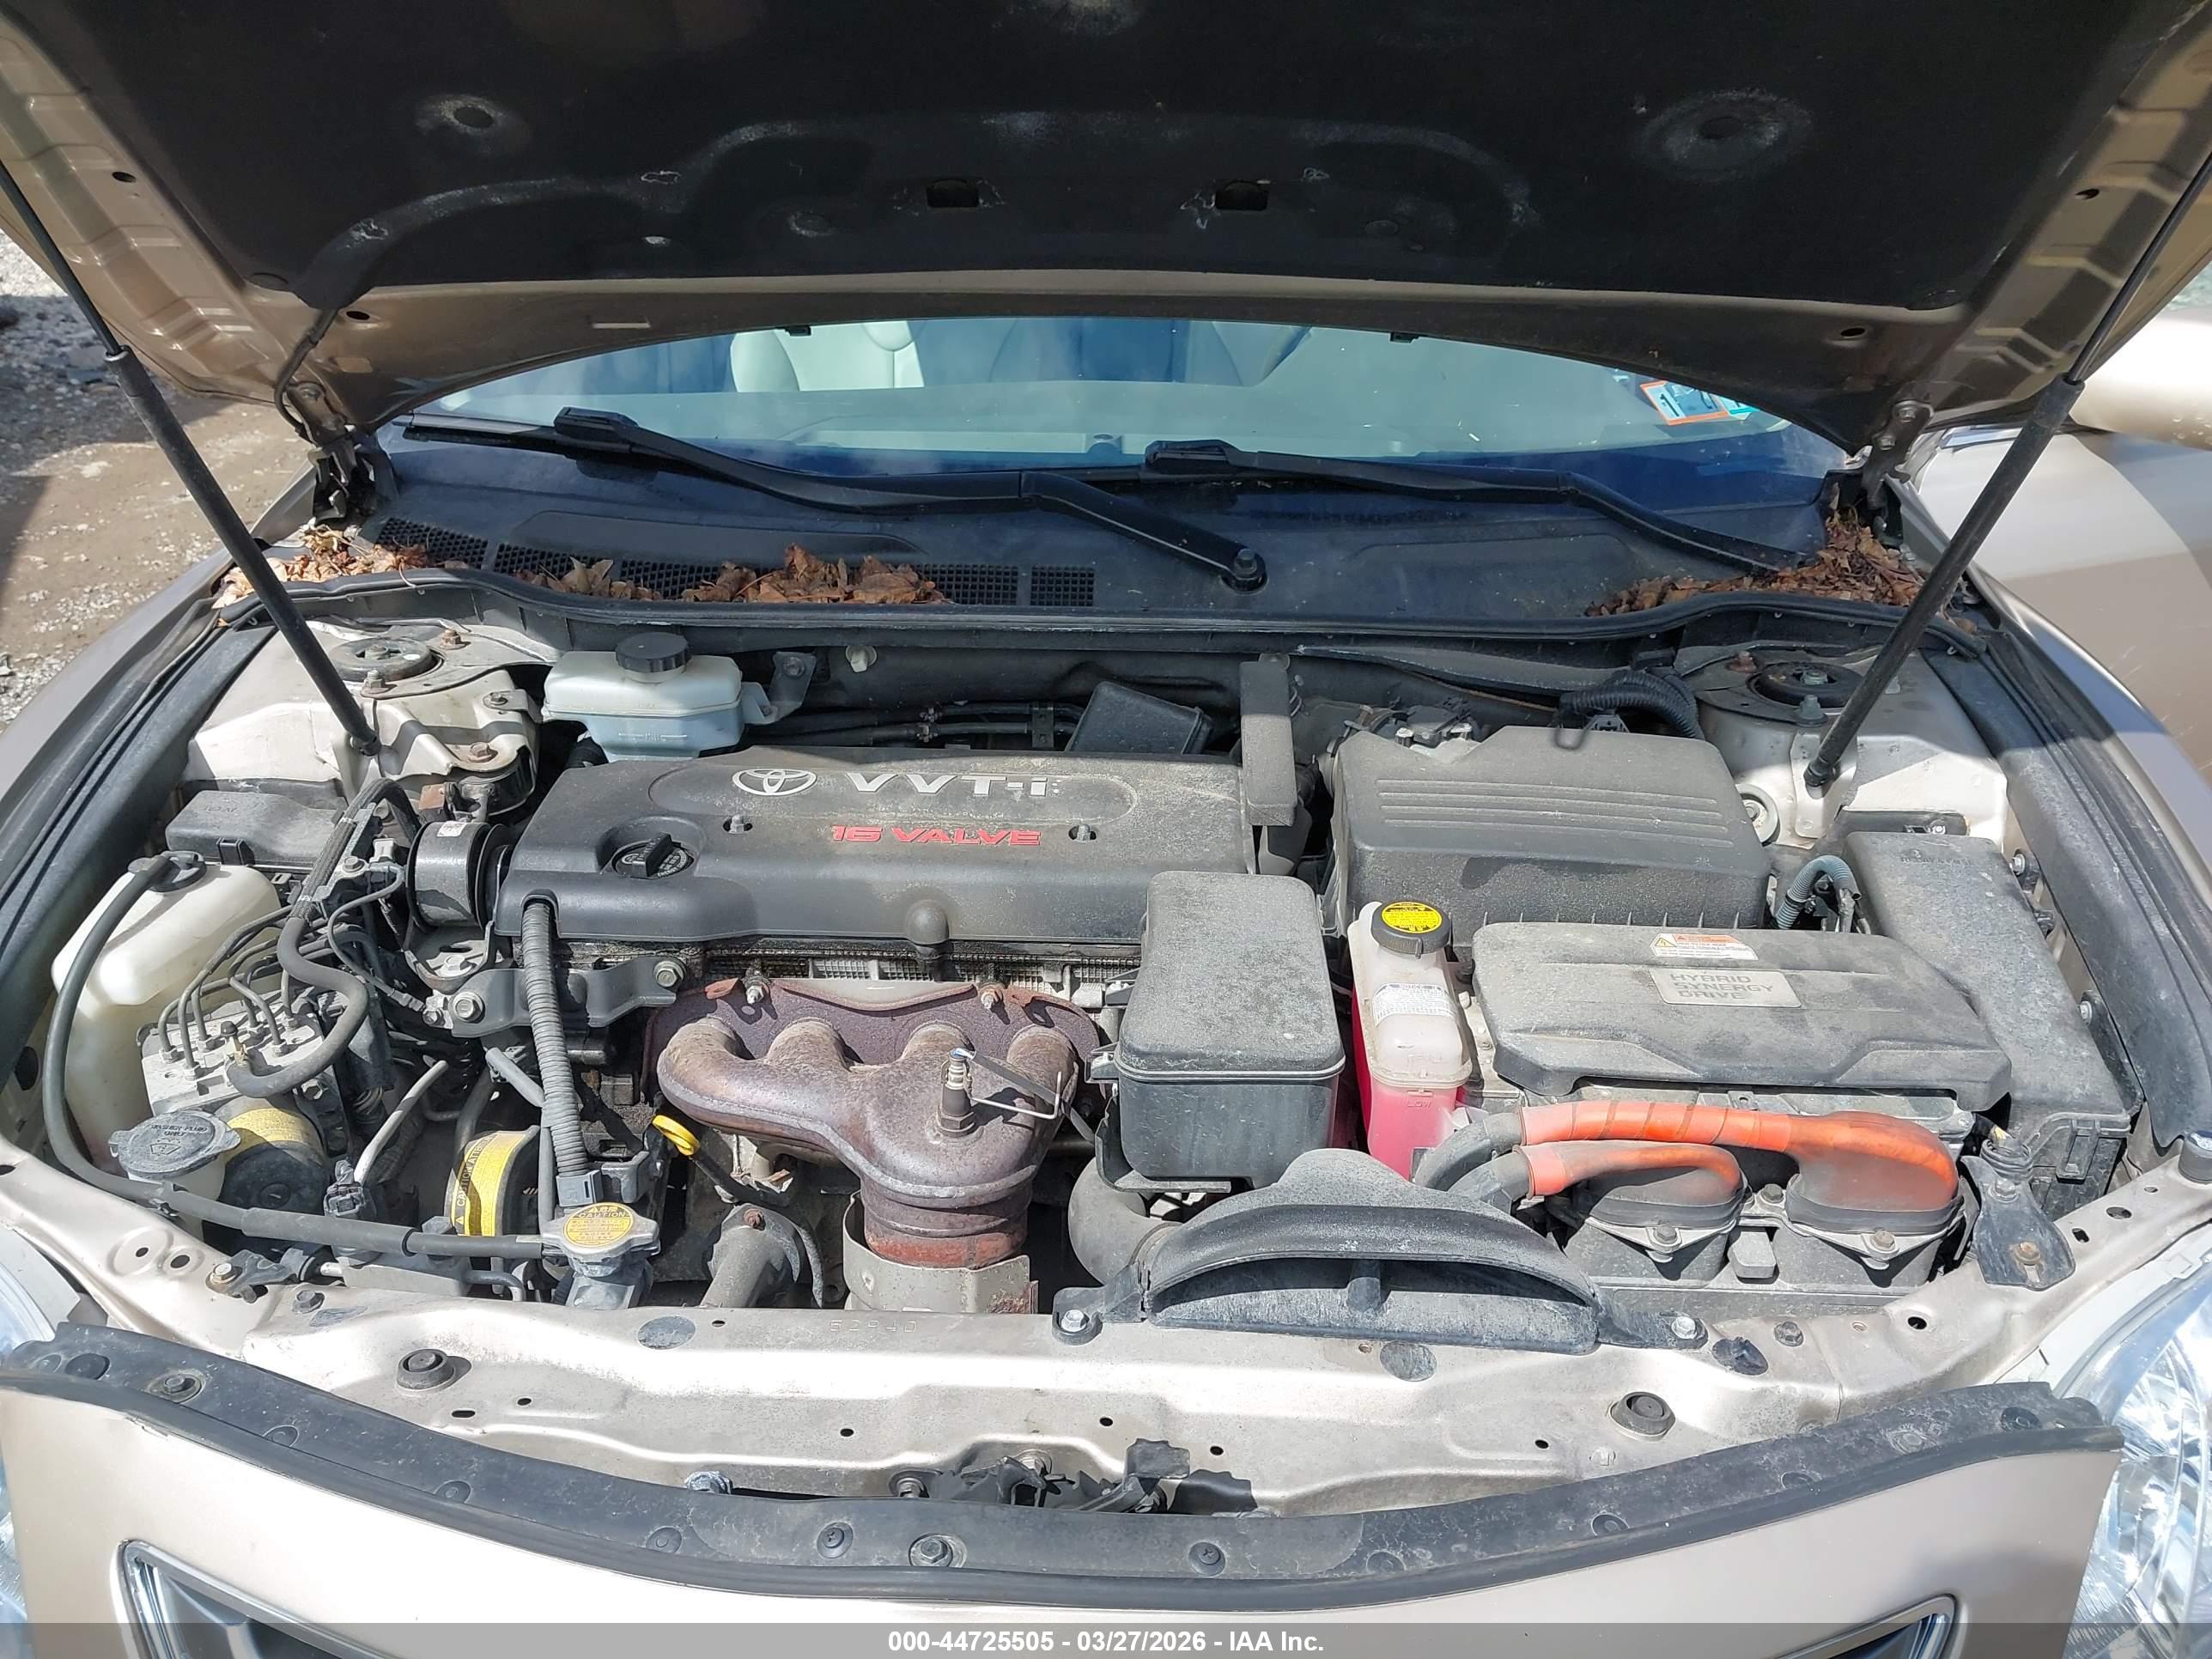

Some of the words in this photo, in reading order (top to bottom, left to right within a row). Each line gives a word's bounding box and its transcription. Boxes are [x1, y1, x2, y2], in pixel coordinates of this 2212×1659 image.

[846, 773, 1048, 797] VVT-i
[832, 825, 883, 842] 16
[890, 827, 1042, 845] VALVE
[1670, 974, 1751, 983] HYBRID
[1674, 981, 1773, 993] SYNERGY
[1678, 990, 1746, 1000] DRIVE
[457, 1164, 471, 1207] CAUTION
